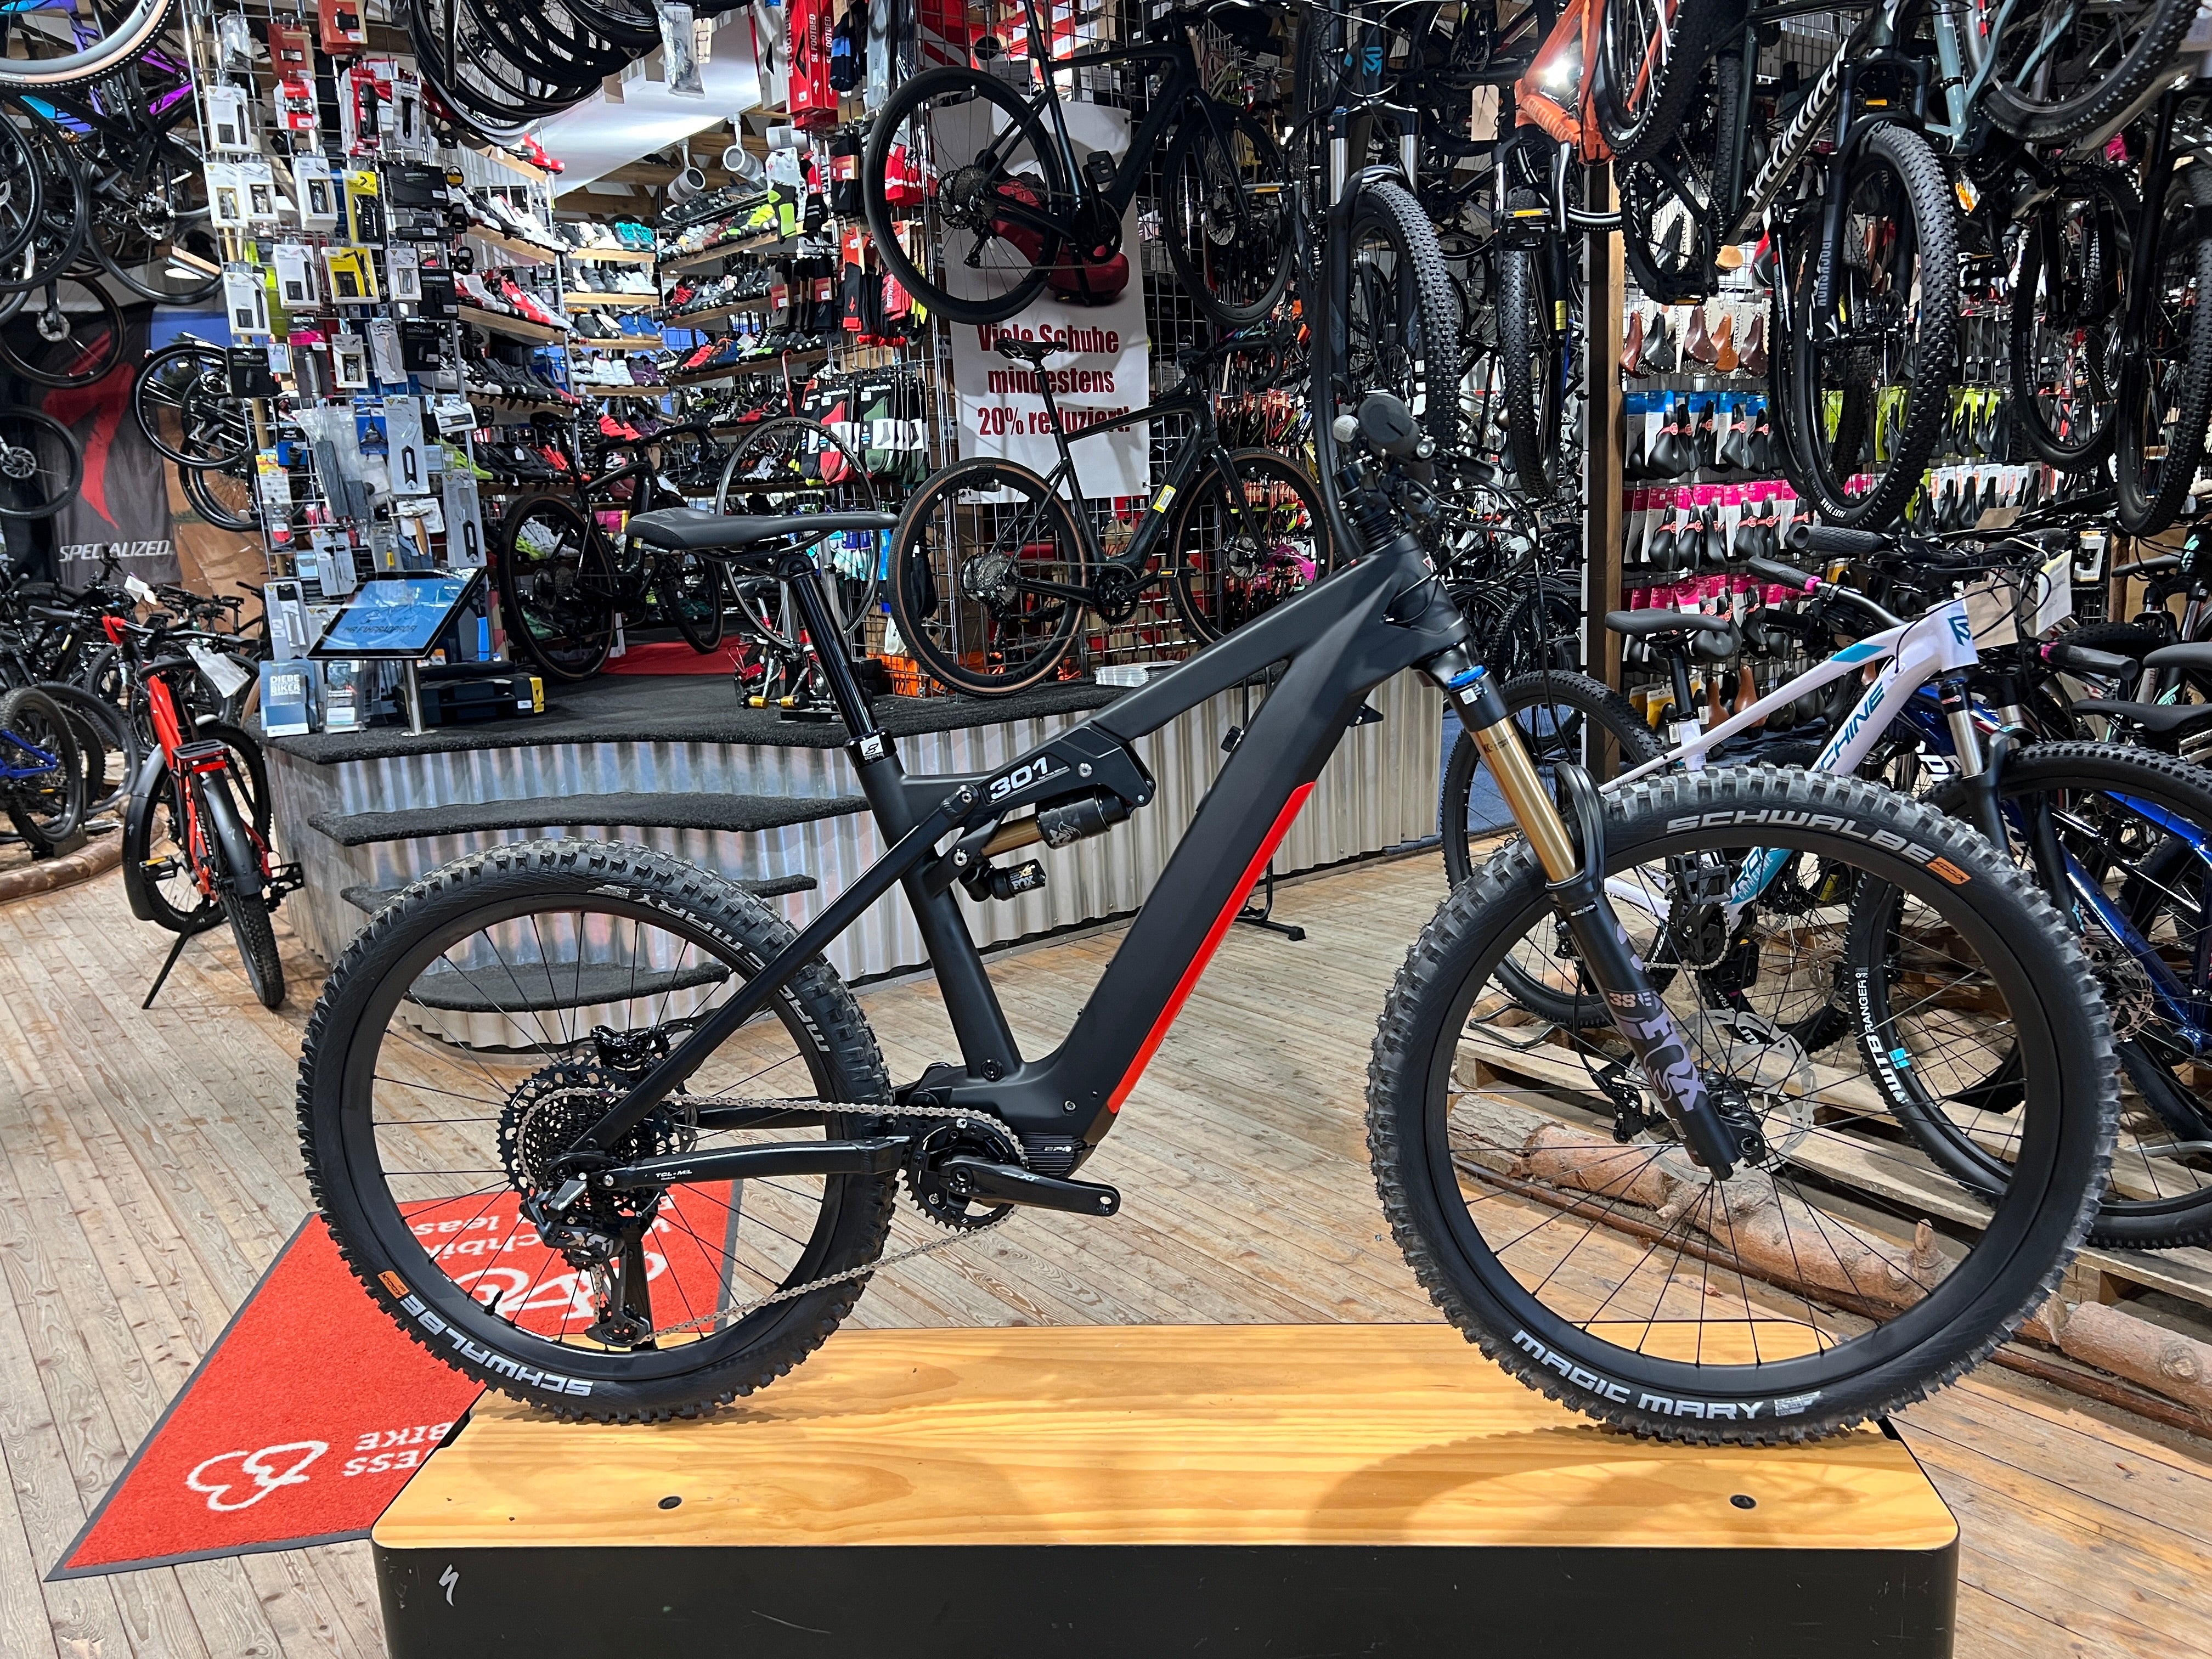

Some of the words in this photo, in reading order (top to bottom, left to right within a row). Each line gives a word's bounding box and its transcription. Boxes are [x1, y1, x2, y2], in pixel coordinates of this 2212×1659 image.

[809, 14, 817, 51] FOOTBED
[825, 16, 833, 53] FOOTBED
[811, 53, 819, 63] SL
[1040, 324, 1119, 353] Schuhe
[978, 407, 1024, 436] 20%
[58, 540, 170, 563] SPECALIZED
[990, 757, 1048, 800] 301
[1666, 809, 1937, 864] SCHWALBE
[1011, 875, 1036, 890] FOX
[1737, 854, 1773, 900] CATHERNE
[1858, 980, 1875, 1032] RANGER
[1866, 1035, 1901, 1092] WTB
[399, 1294, 594, 1396] SCHWALBE
[1511, 1329, 1631, 1404] MAGIC
[1638, 1393, 1764, 1420] MARY
[354, 1421, 454, 1452] BIKE
